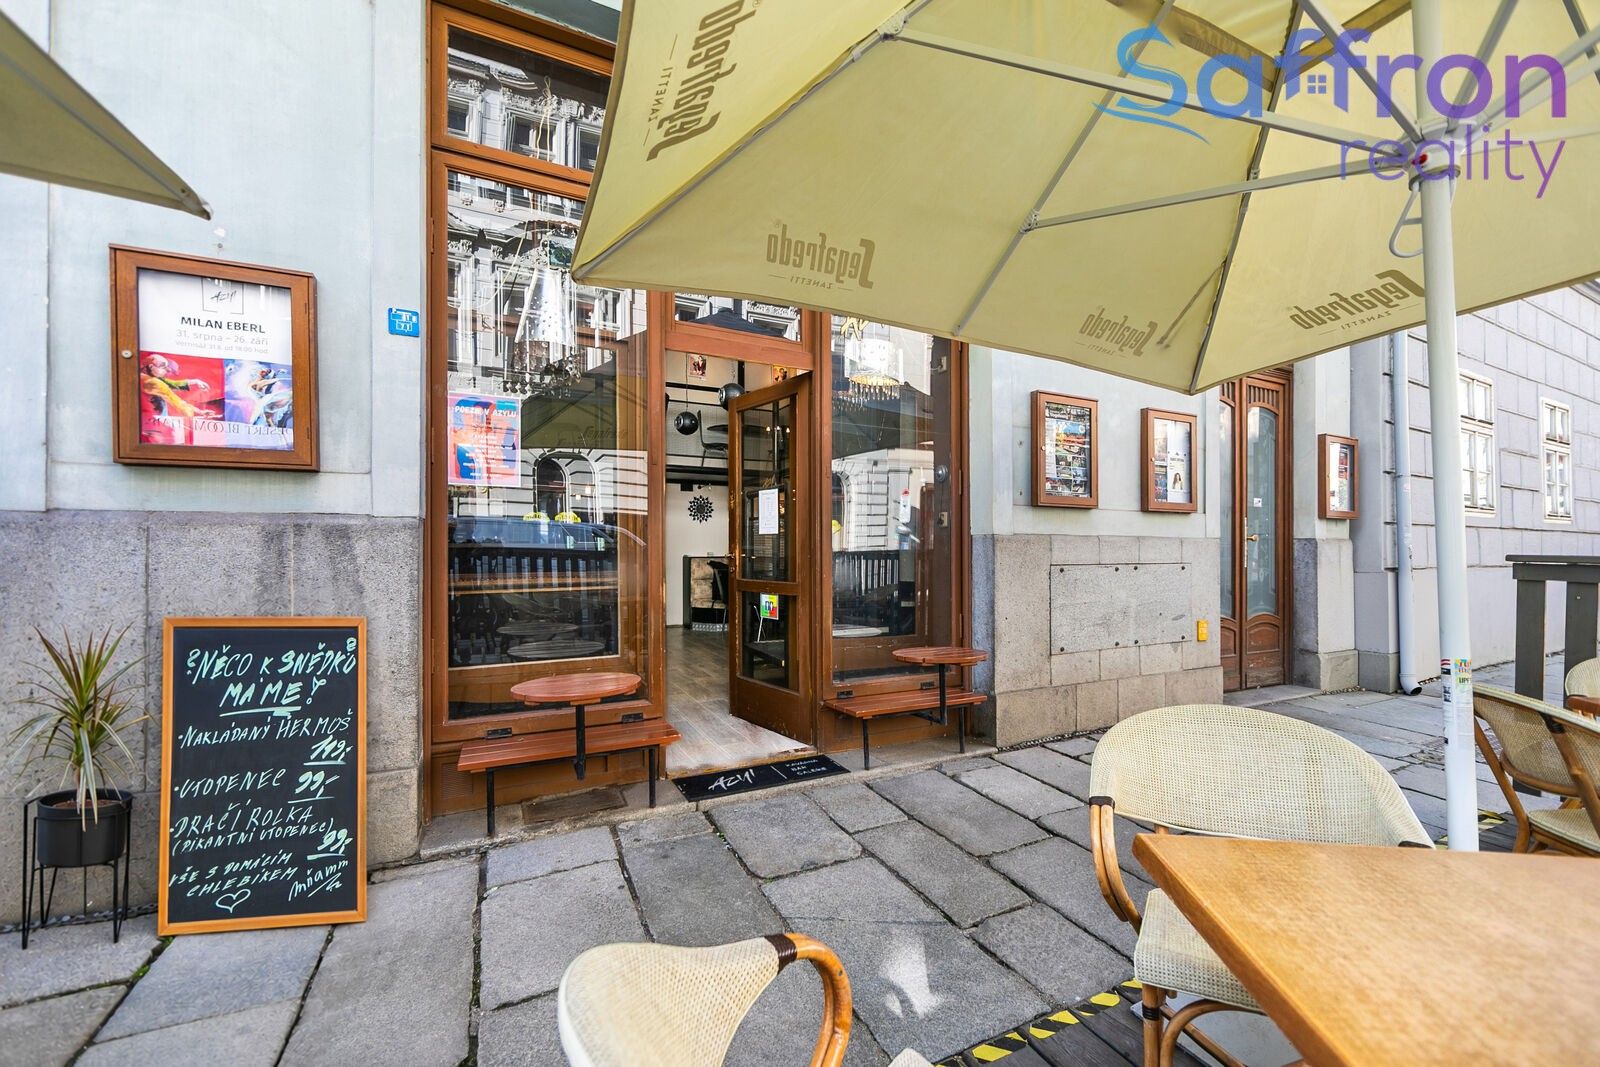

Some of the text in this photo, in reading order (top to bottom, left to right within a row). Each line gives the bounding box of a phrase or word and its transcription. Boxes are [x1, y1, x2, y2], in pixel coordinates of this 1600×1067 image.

[181, 316, 266, 334] MILAN EBERL
[246, 806, 313, 831] ROLKA
